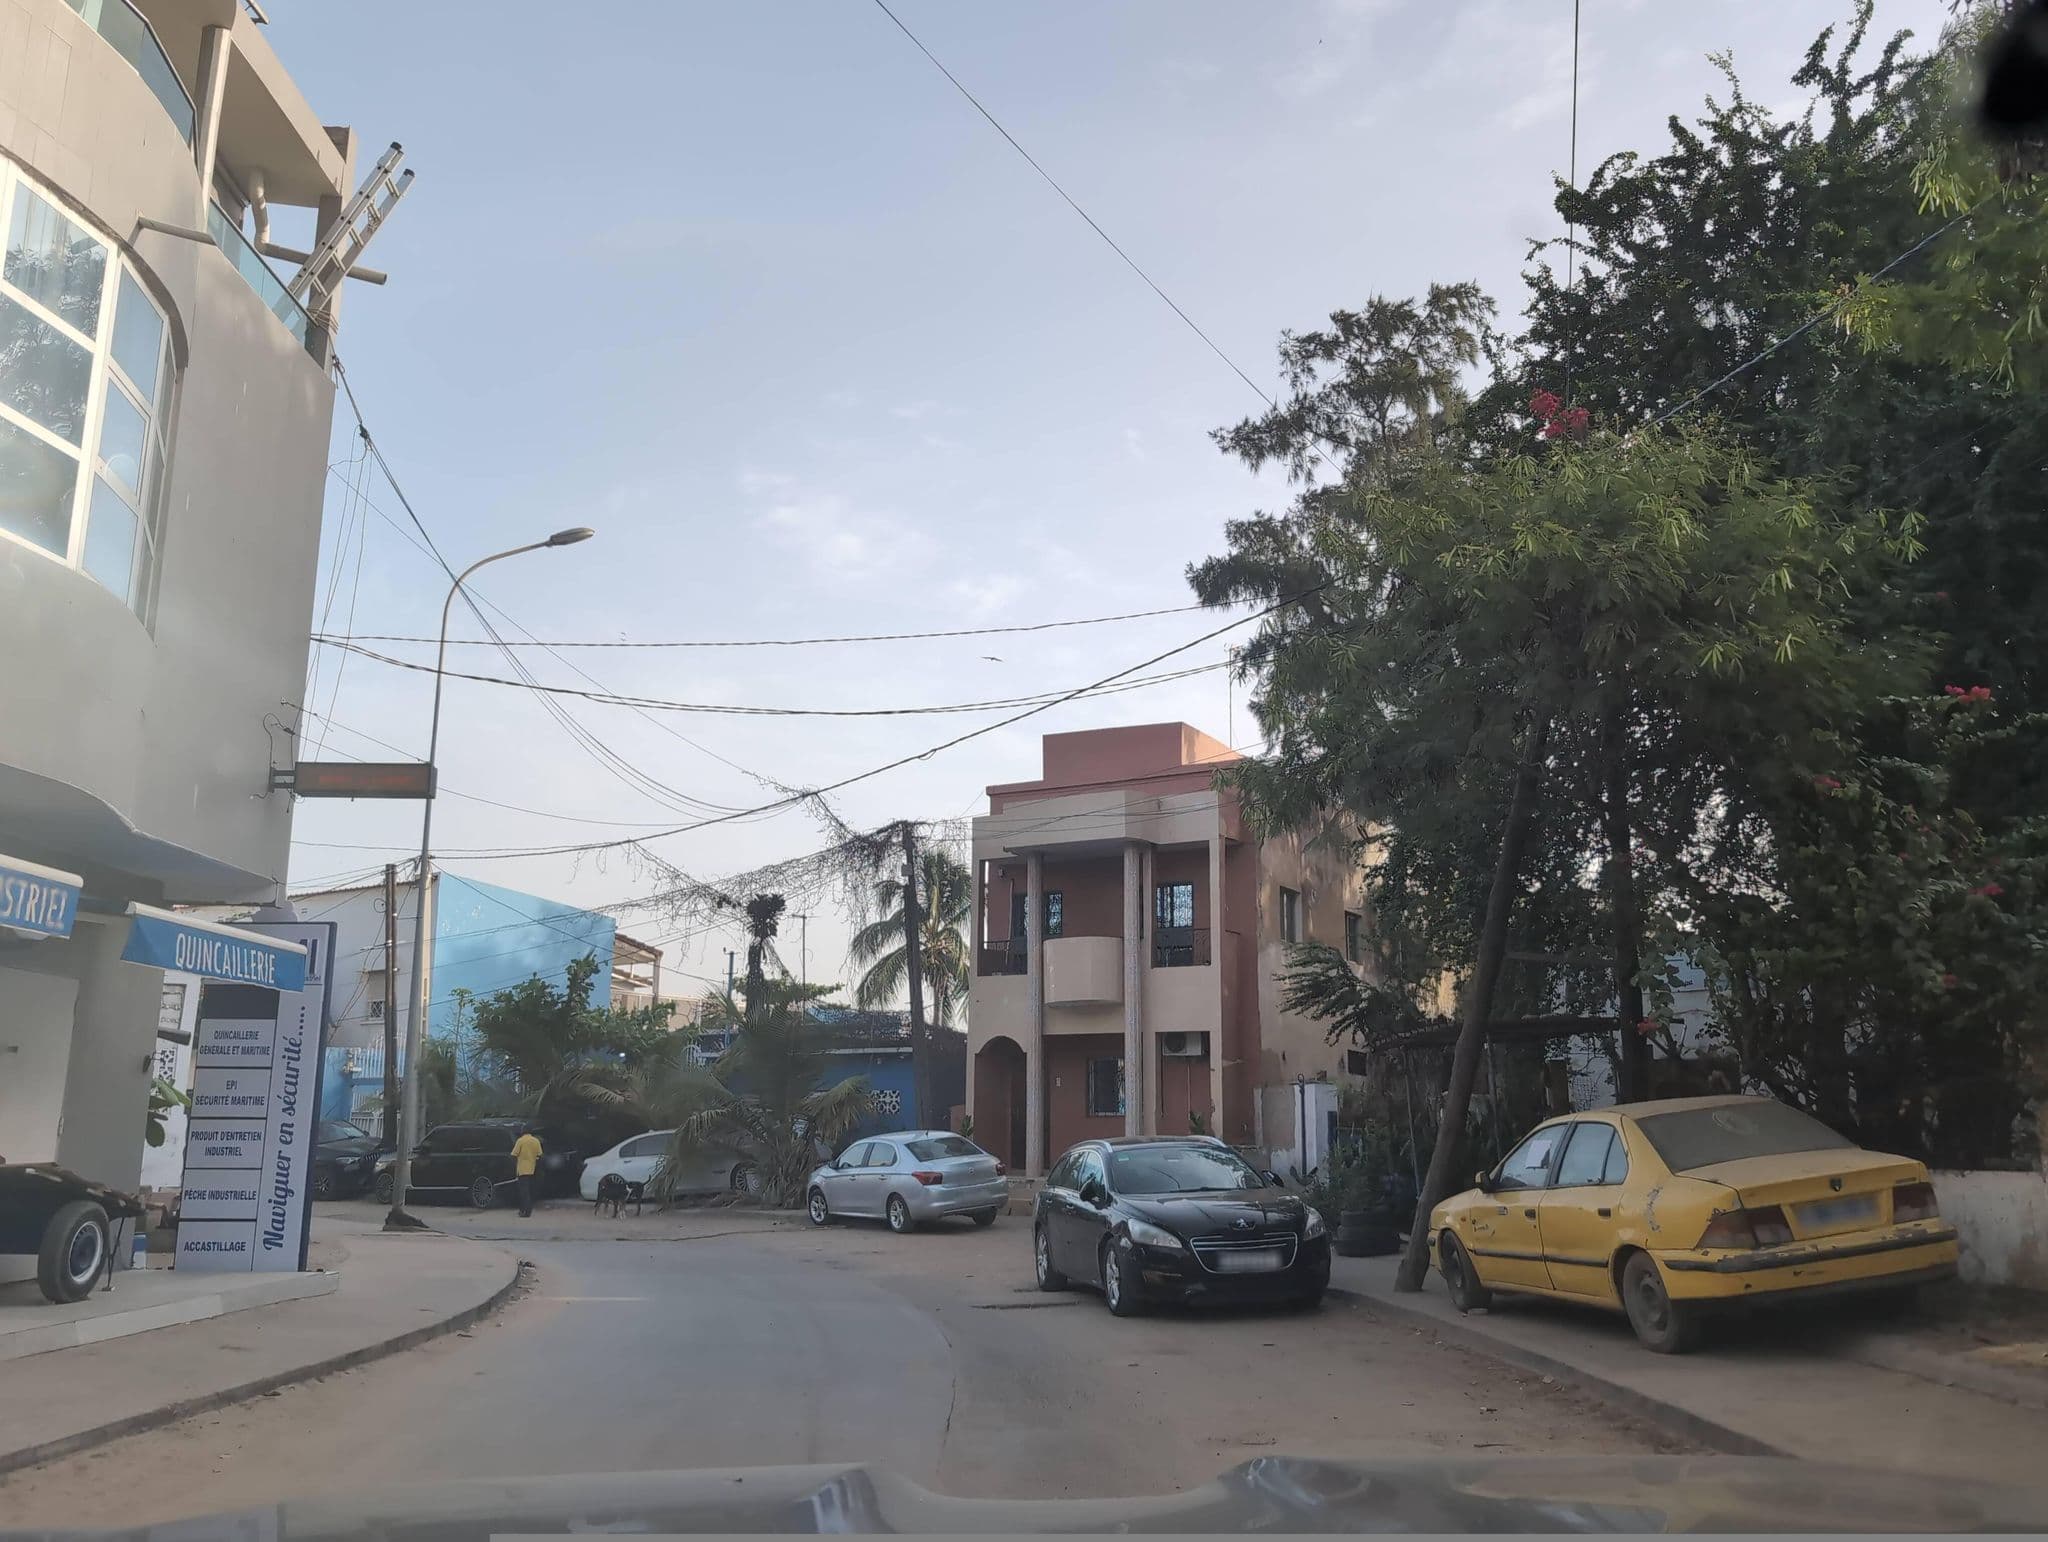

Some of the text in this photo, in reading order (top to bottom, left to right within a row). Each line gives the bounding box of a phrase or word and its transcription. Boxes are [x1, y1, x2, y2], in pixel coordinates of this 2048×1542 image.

[176, 932, 276, 984] QUINCAILLERIE
[213, 1030, 260, 1040] QUINCAILLERIE
[232, 1045, 240, 1055] ET
[241, 1045, 271, 1056] MARITIME
[226, 1080, 237, 1090] EPI
[231, 1095, 265, 1106] MARITIME
[191, 1131, 262, 1141] PRODUIT D'ENTRETIEN
[205, 1146, 242, 1157] INDUSTRIEL
[262, 1150, 295, 1251] Naviguer
[279, 1122, 294, 1145] en
[208, 1190, 256, 1200] INDUSTRIELLE
[184, 1241, 247, 1252] ACCASTILLAGE
